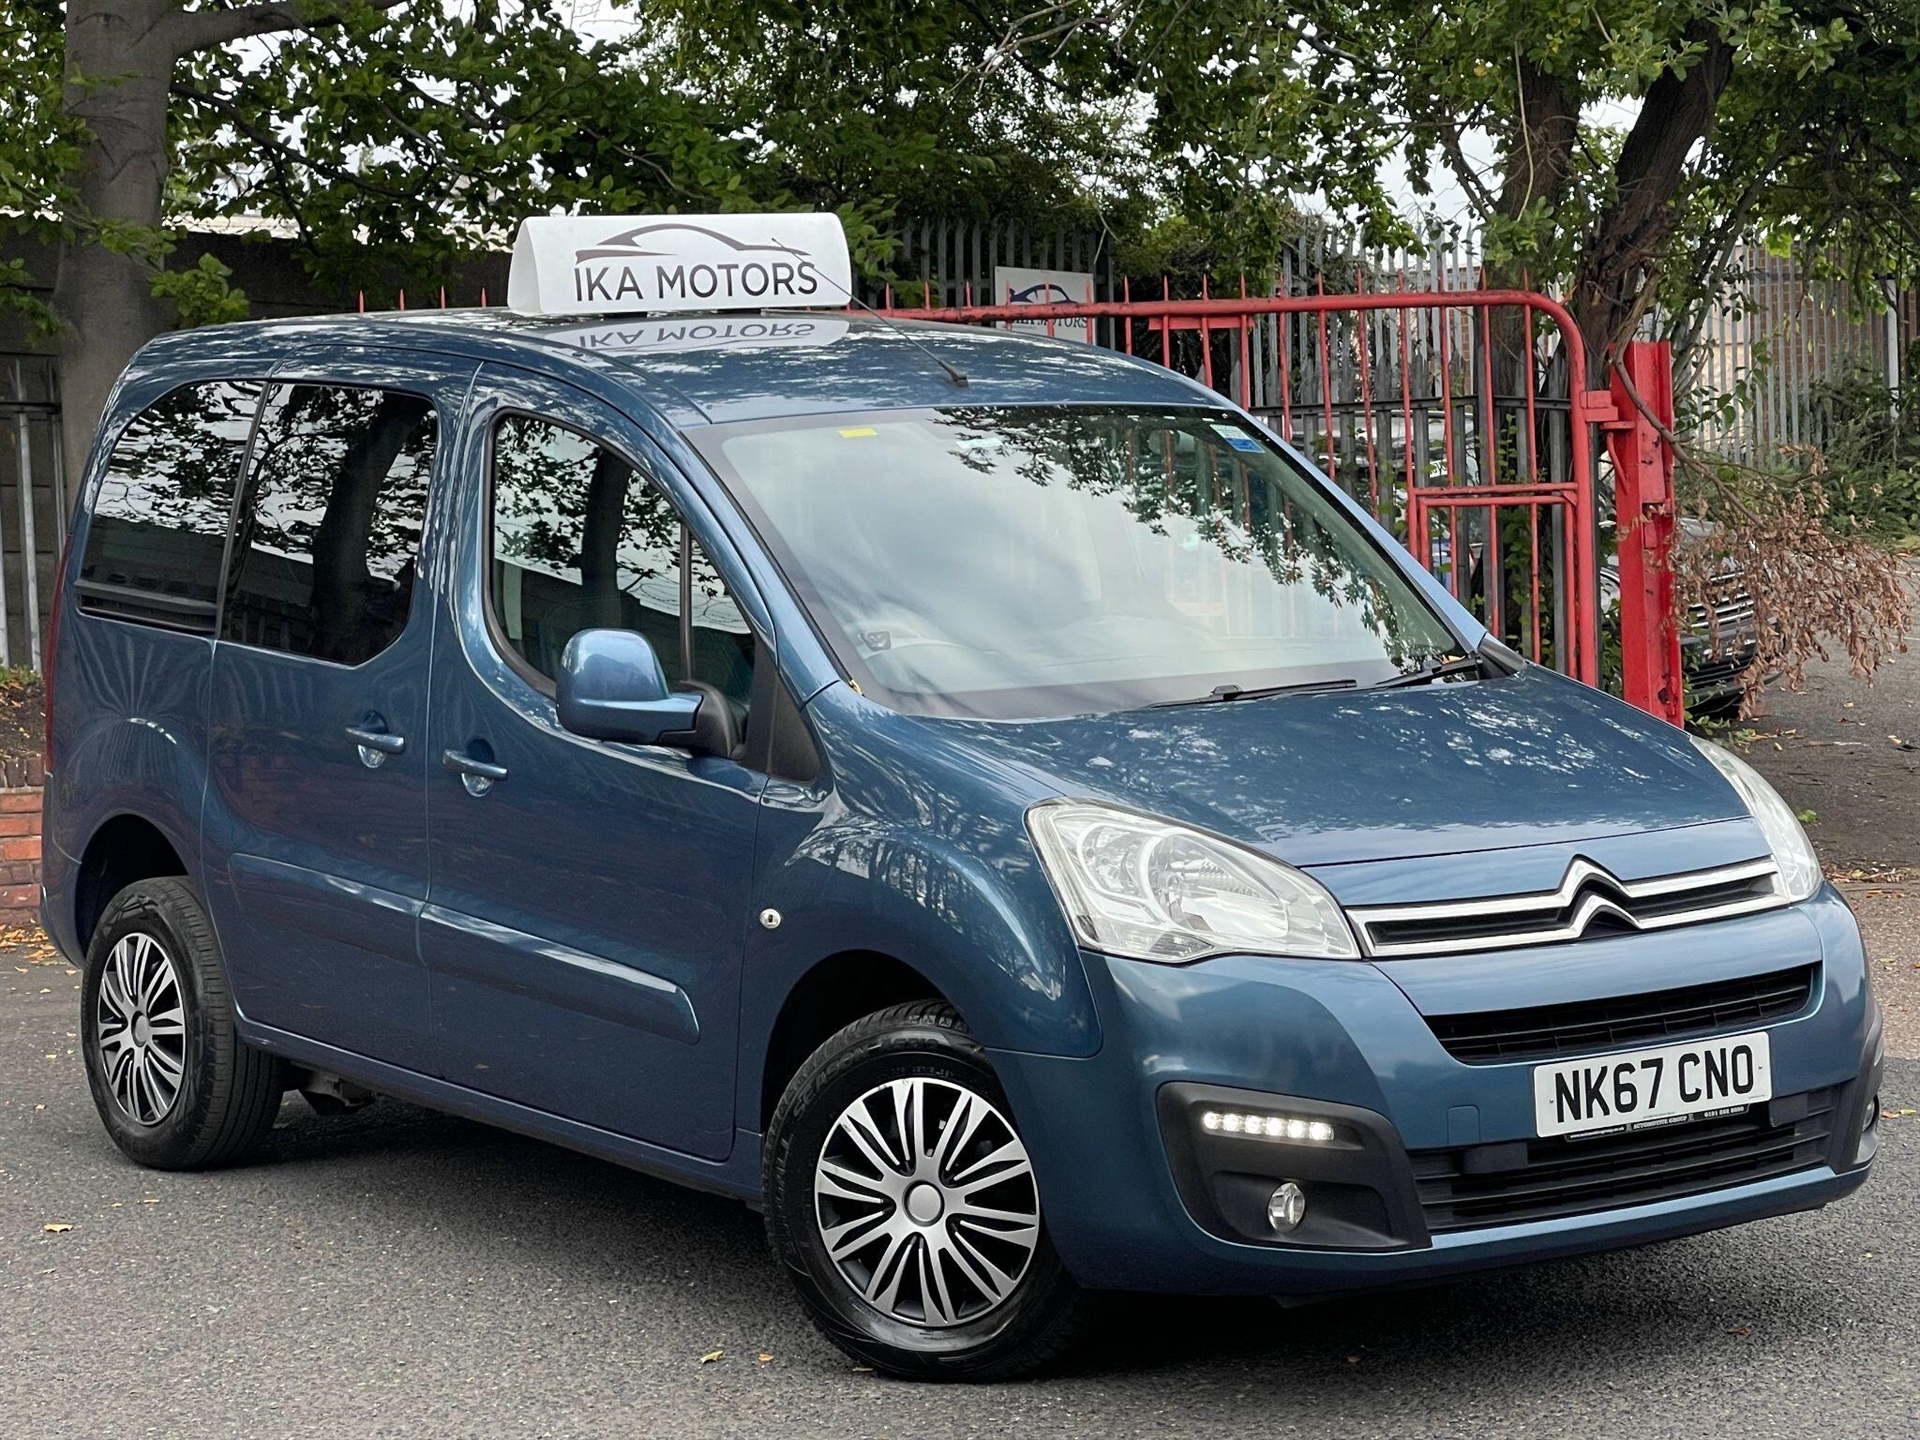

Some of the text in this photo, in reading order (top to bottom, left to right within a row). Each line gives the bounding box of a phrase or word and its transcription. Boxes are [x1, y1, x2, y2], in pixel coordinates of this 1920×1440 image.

[574, 262, 818, 301] IKA MOTORS
[1555, 1044, 1754, 1123] NK67 CNO
